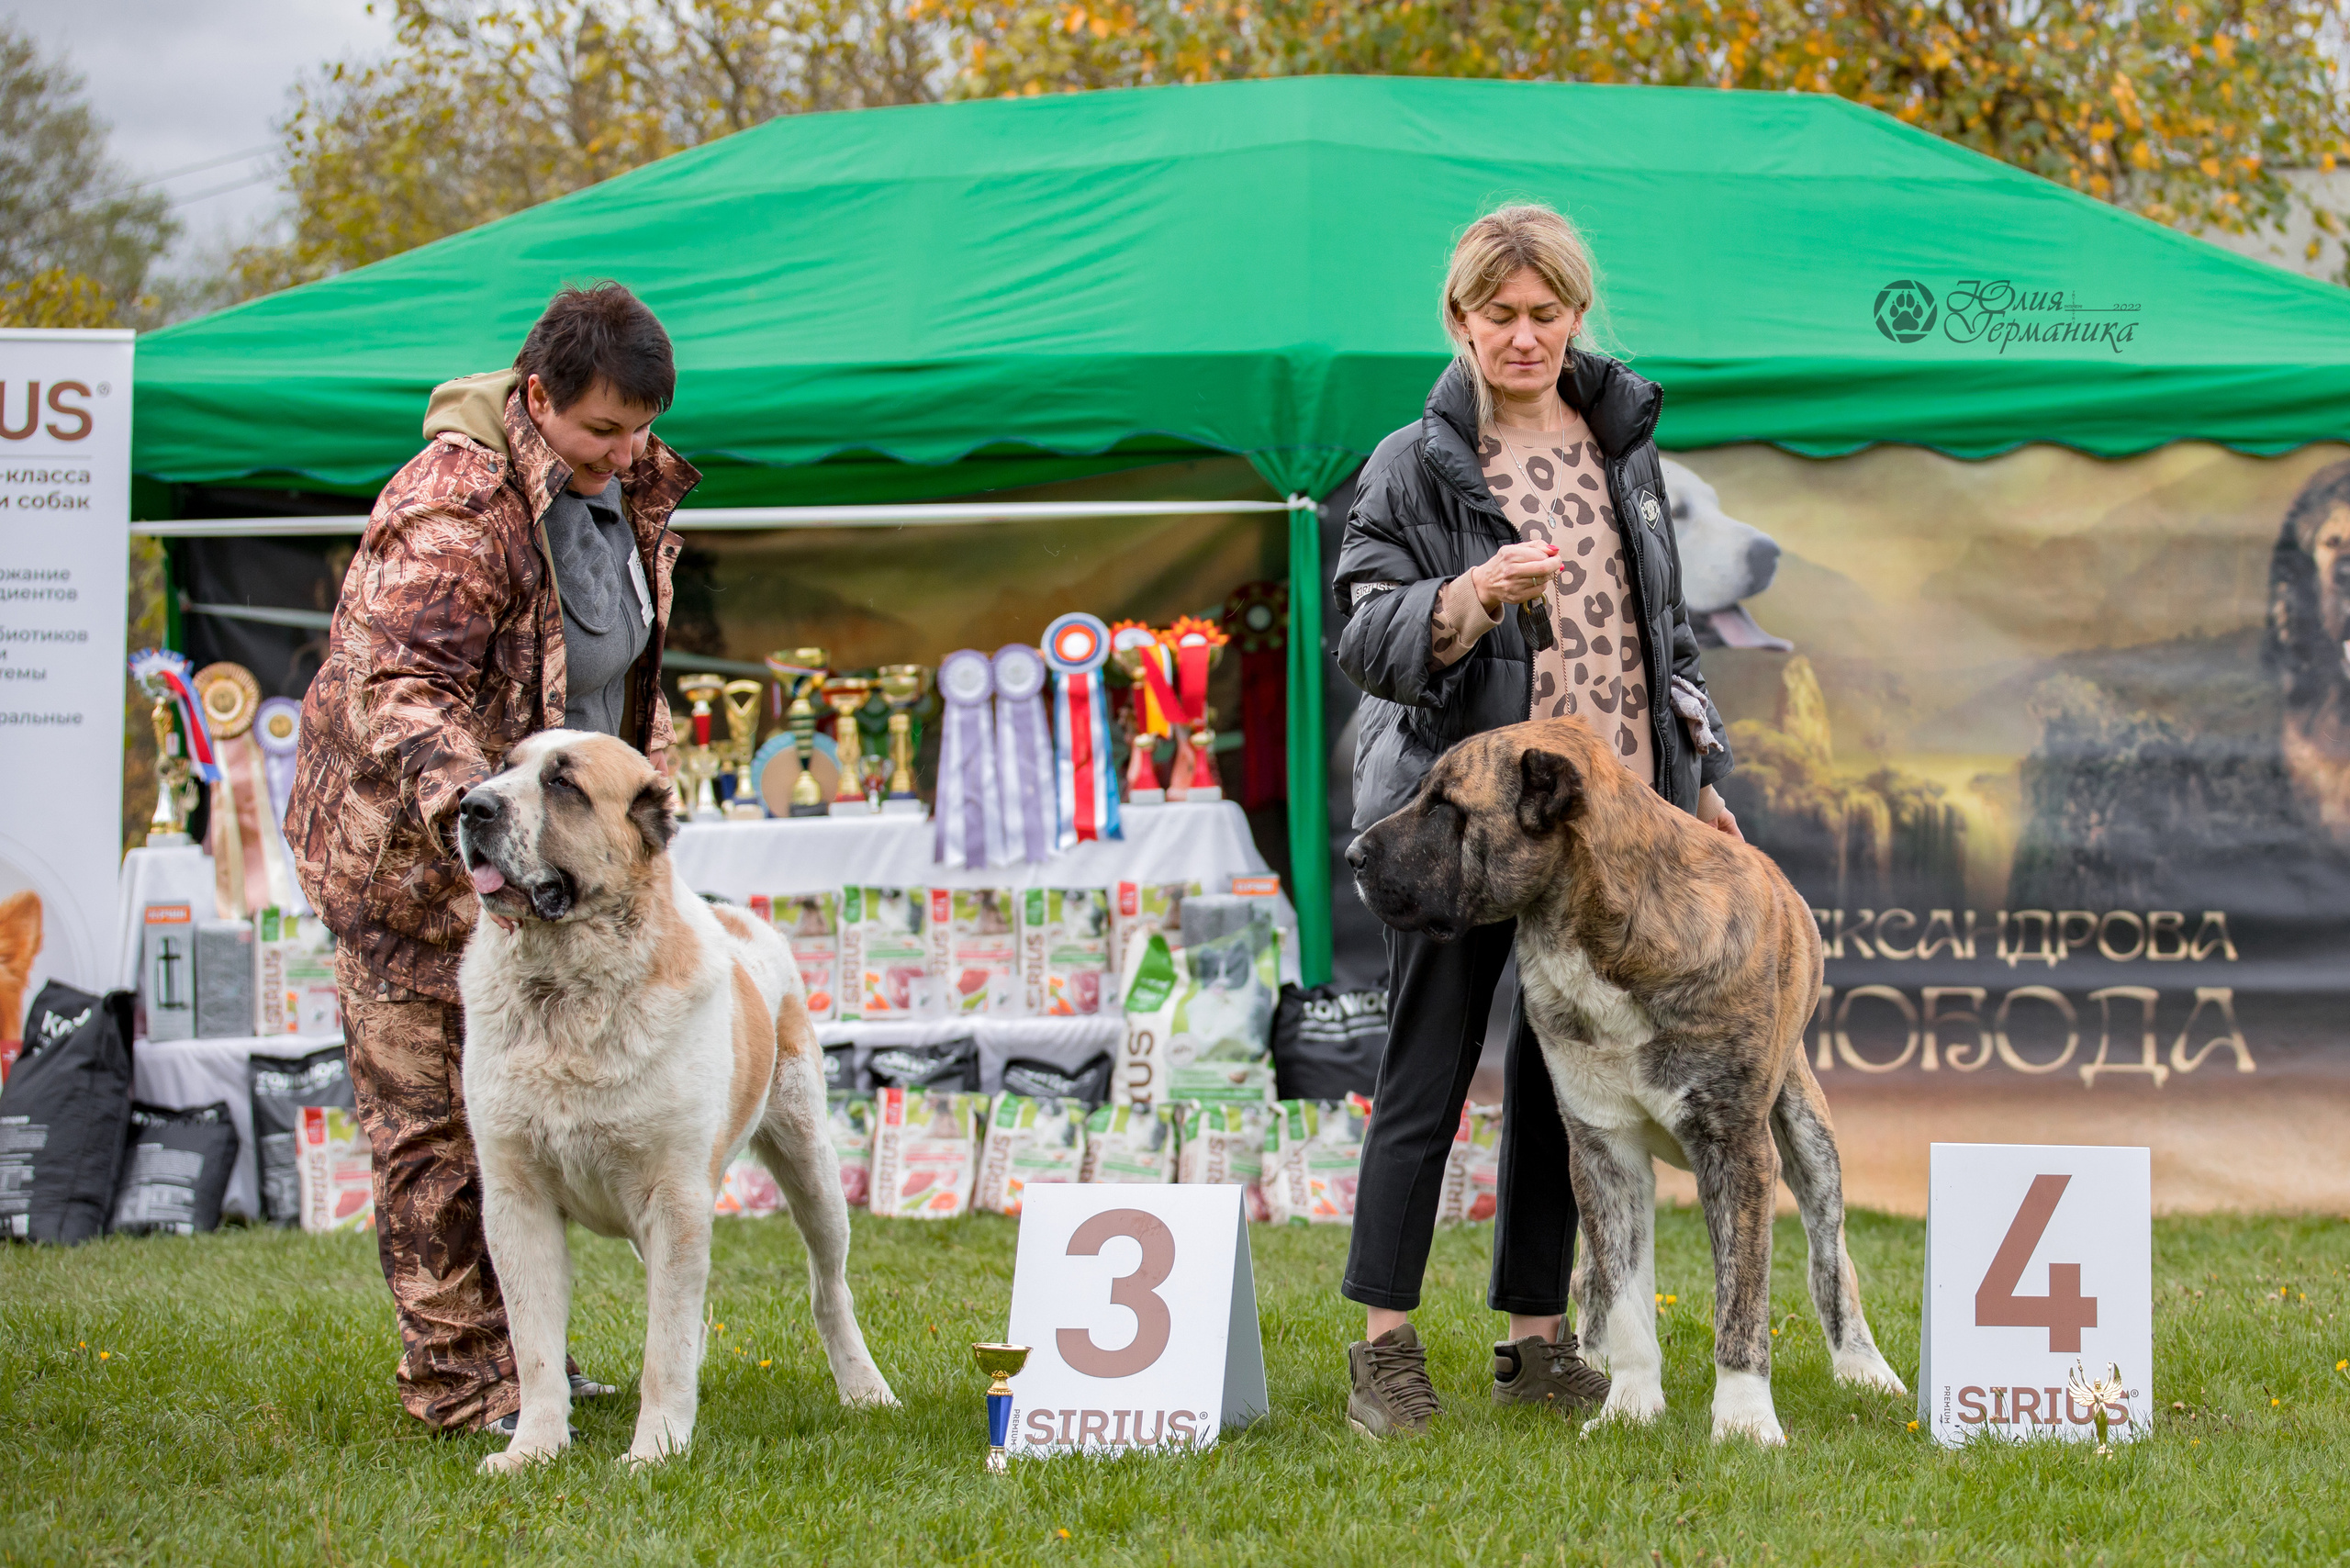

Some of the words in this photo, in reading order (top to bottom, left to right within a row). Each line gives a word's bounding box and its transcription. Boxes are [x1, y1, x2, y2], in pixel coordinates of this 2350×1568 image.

[17, 490, 90, 510] собак
[0, 667, 47, 679] емы
[1975, 1174, 2098, 1352] 4
[1056, 1208, 1176, 1378] 3
[1010, 1408, 1021, 1446] PREMIUM
